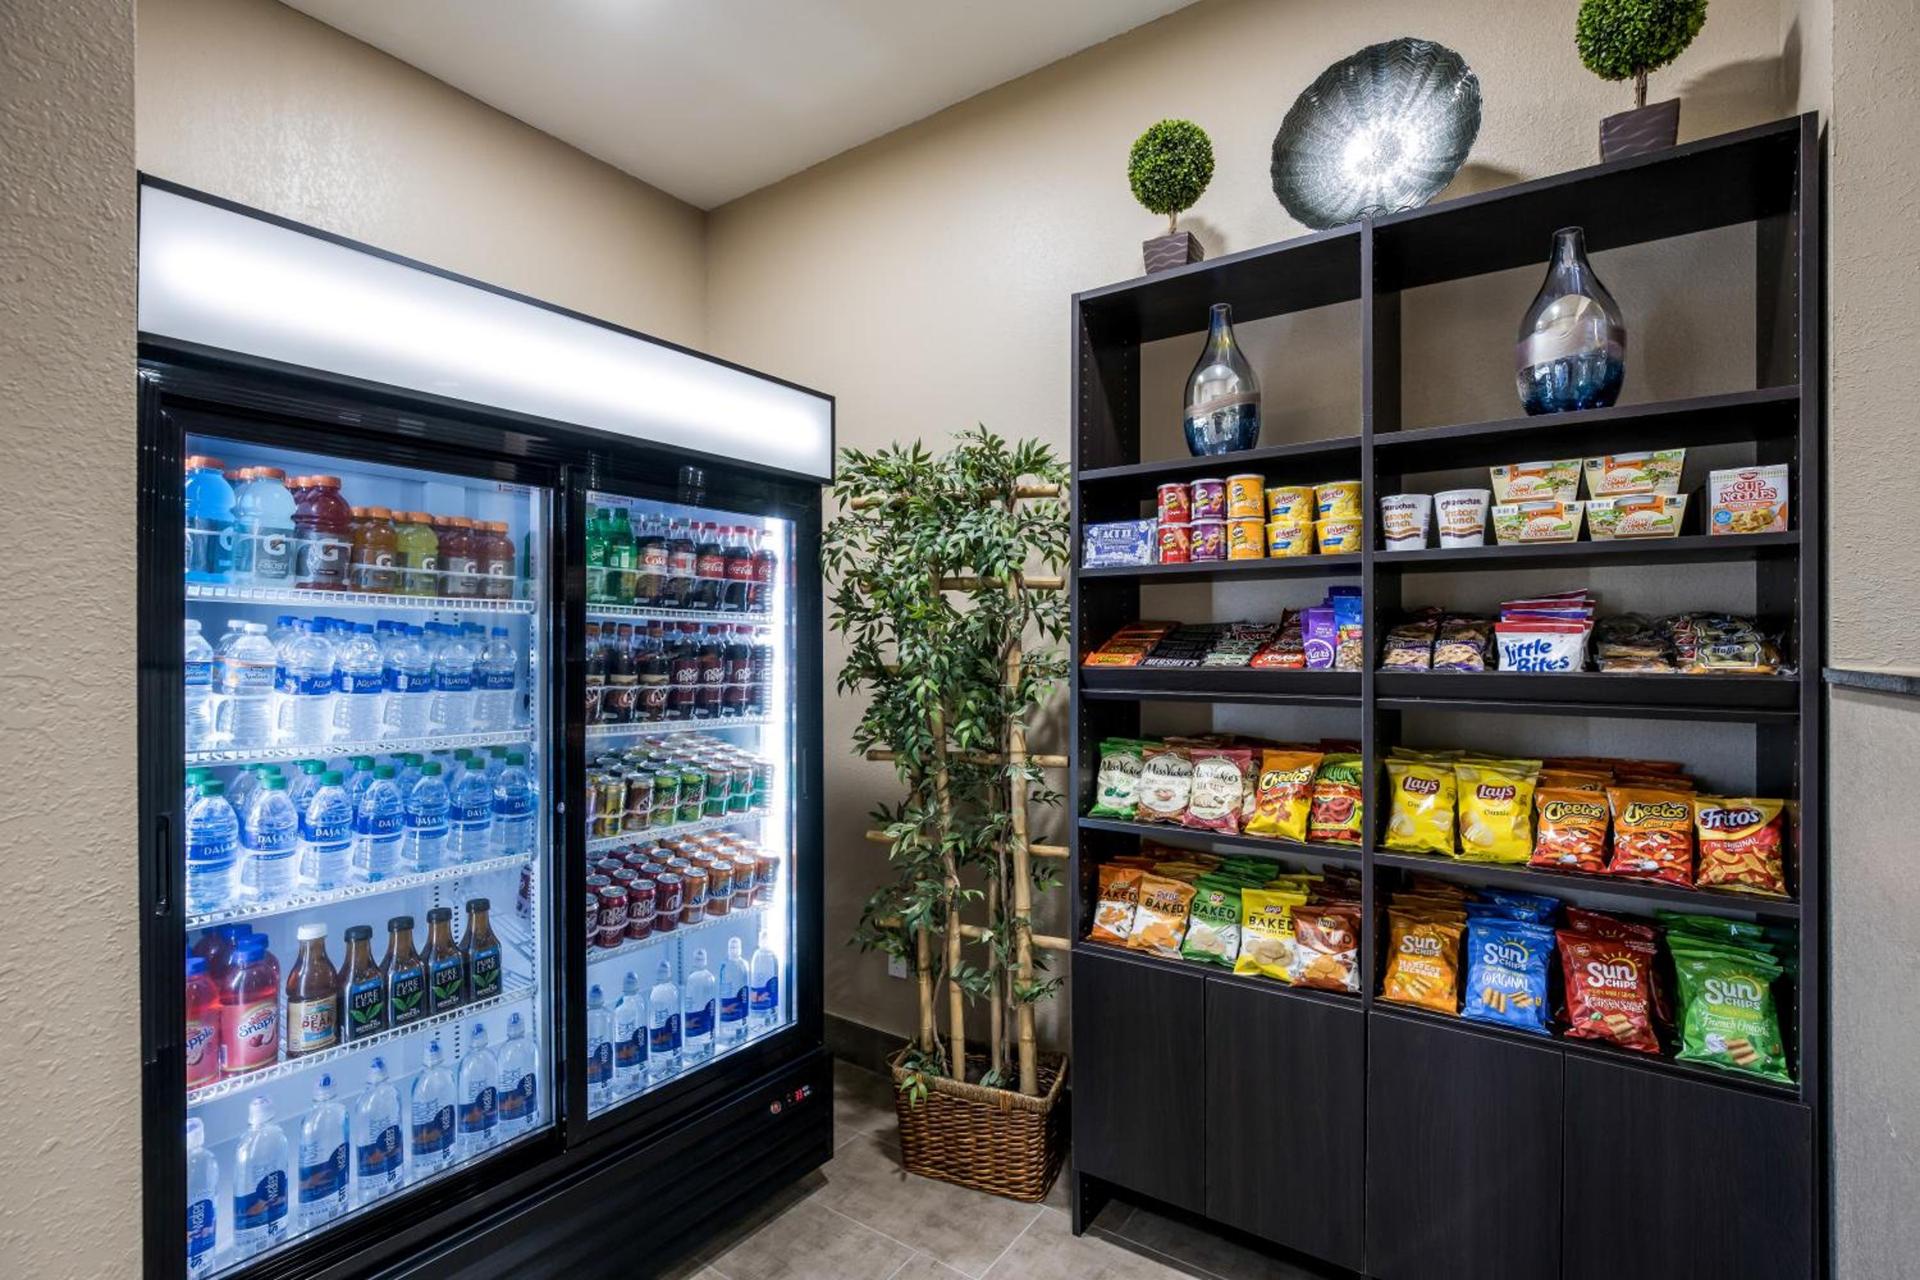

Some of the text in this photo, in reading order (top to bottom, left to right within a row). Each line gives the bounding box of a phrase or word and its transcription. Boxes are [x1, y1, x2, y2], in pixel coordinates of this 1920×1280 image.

[1733, 479, 1766, 492] CUP
[1505, 639, 1552, 667] Little
[1517, 656, 1570, 672] Bites
[1405, 776, 1439, 795] Lay's
[1479, 785, 1514, 802] Lay's
[1545, 801, 1605, 821] Cheetos
[1624, 801, 1688, 824] Cheetos
[1700, 808, 1761, 829] Fritos
[1193, 901, 1237, 920] BAKED
[1400, 934, 1442, 953] Sun
[1483, 942, 1530, 965] Sun
[1587, 961, 1638, 987] Sun
[1604, 979, 1638, 990] CHIPS
[1704, 978, 1761, 1005] Sun
[1724, 997, 1761, 1011] CHIPS
